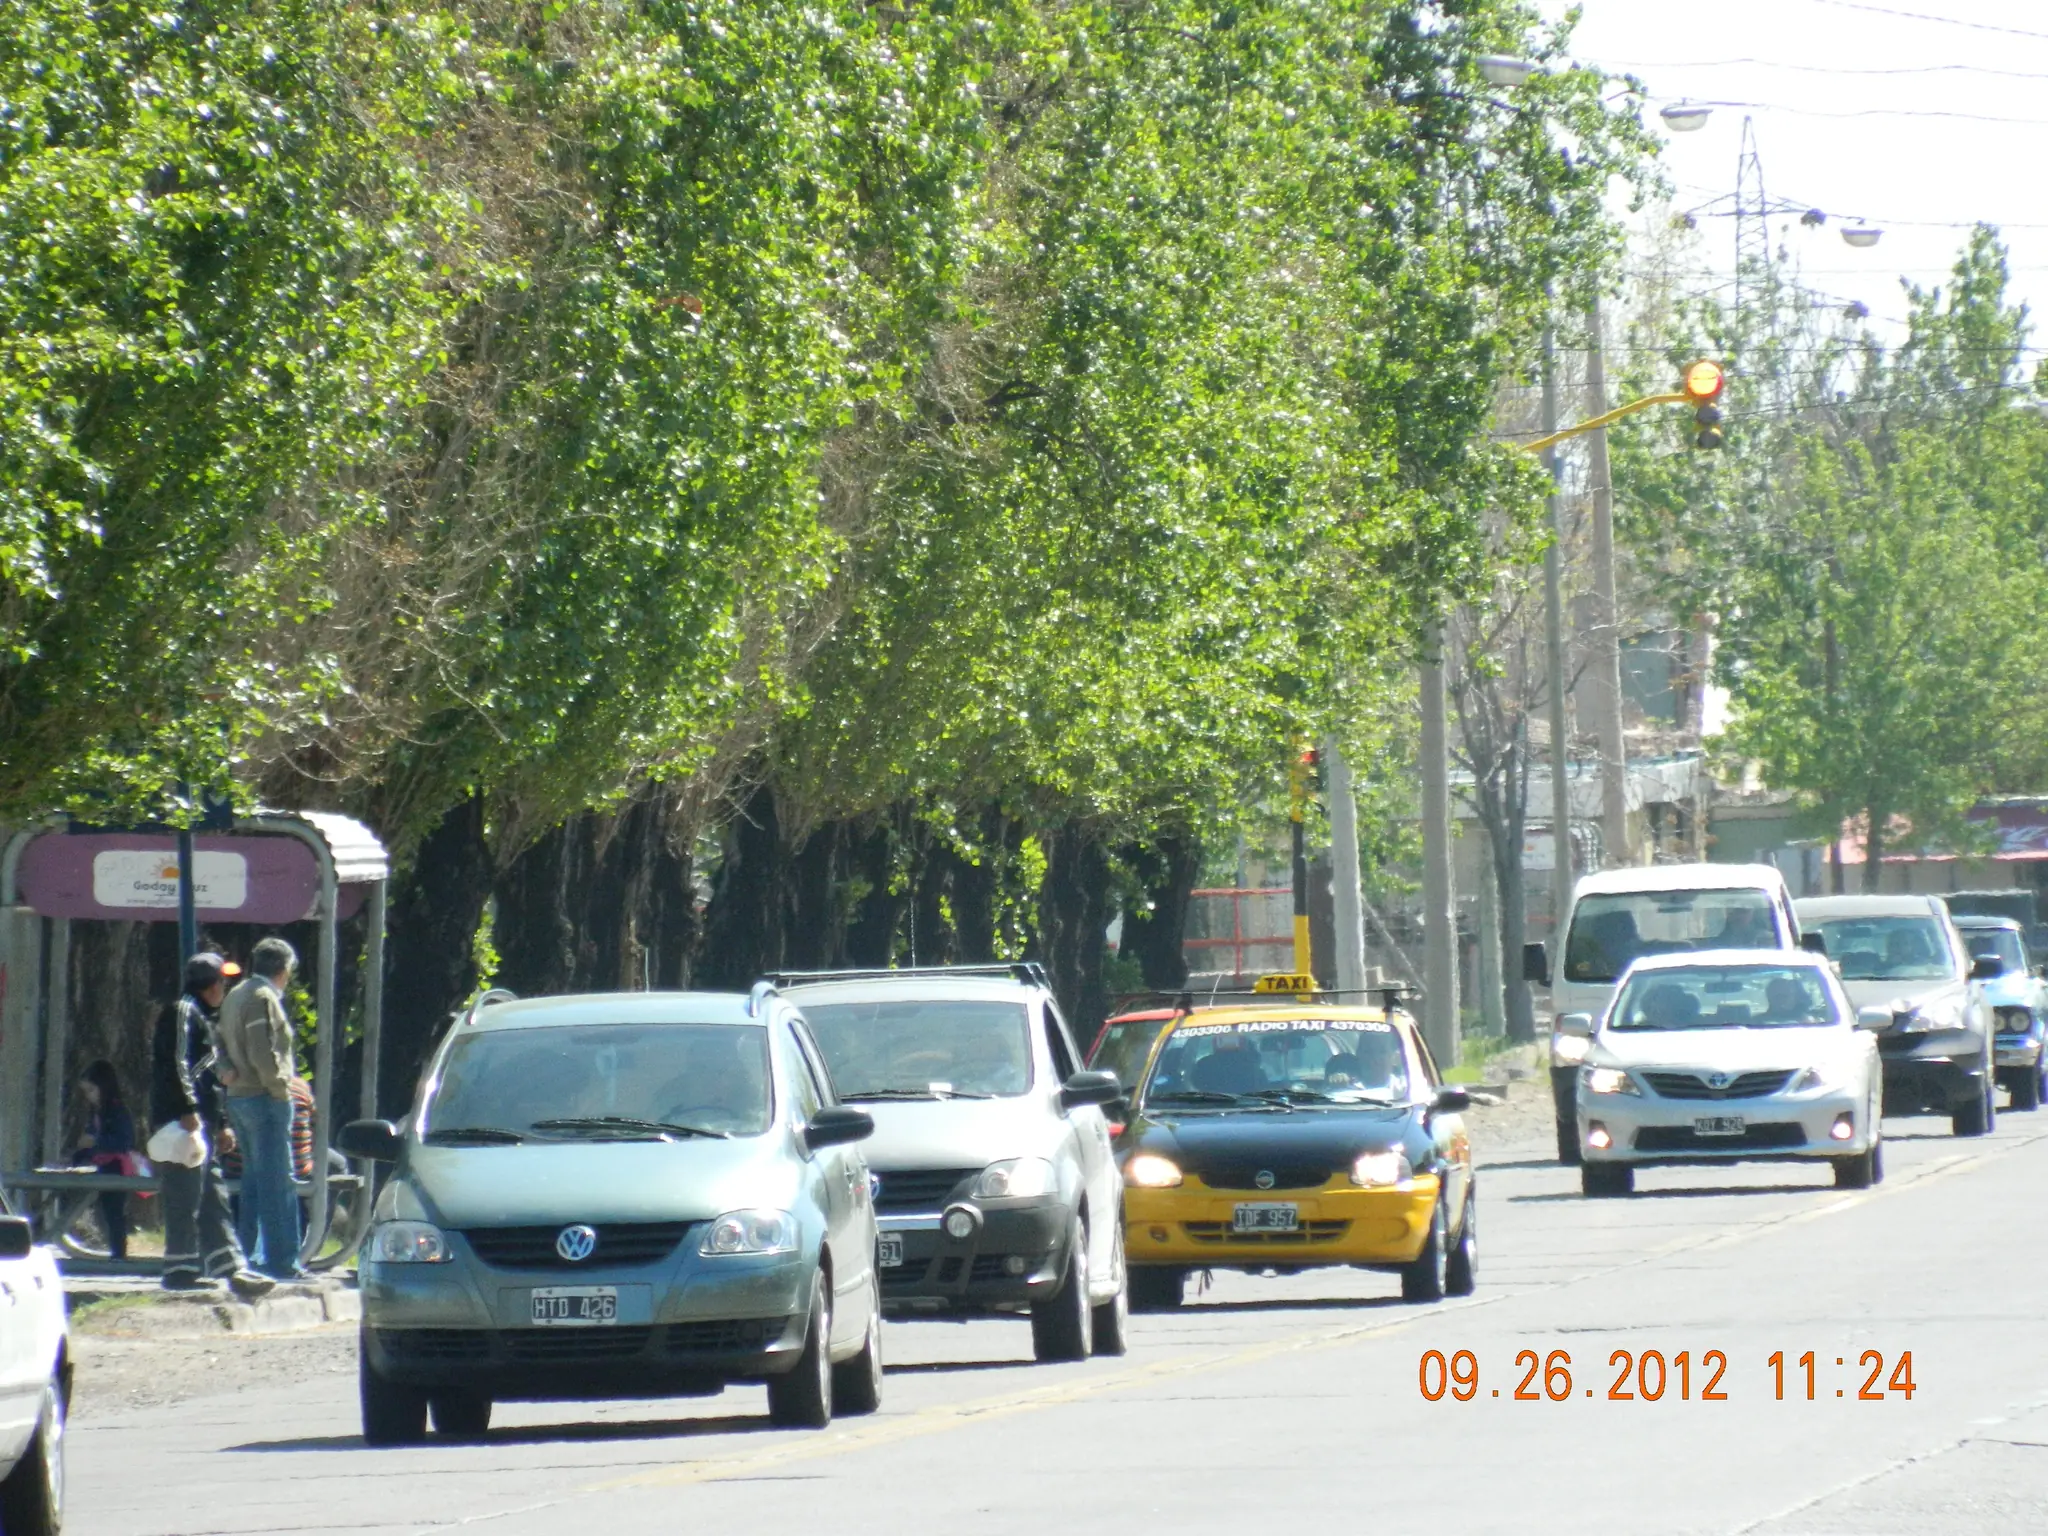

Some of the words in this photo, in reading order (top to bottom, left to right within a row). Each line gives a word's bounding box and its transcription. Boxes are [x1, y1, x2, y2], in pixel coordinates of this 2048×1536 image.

[1265, 977, 1308, 990] TAXI
[1238, 1022, 1287, 1032] RADIO
[1292, 1021, 1326, 1031] TAXI
[1269, 1209, 1295, 1226] 957
[880, 1243, 898, 1260] 61
[535, 1298, 568, 1318] HTD
[580, 1297, 614, 1317] 426
